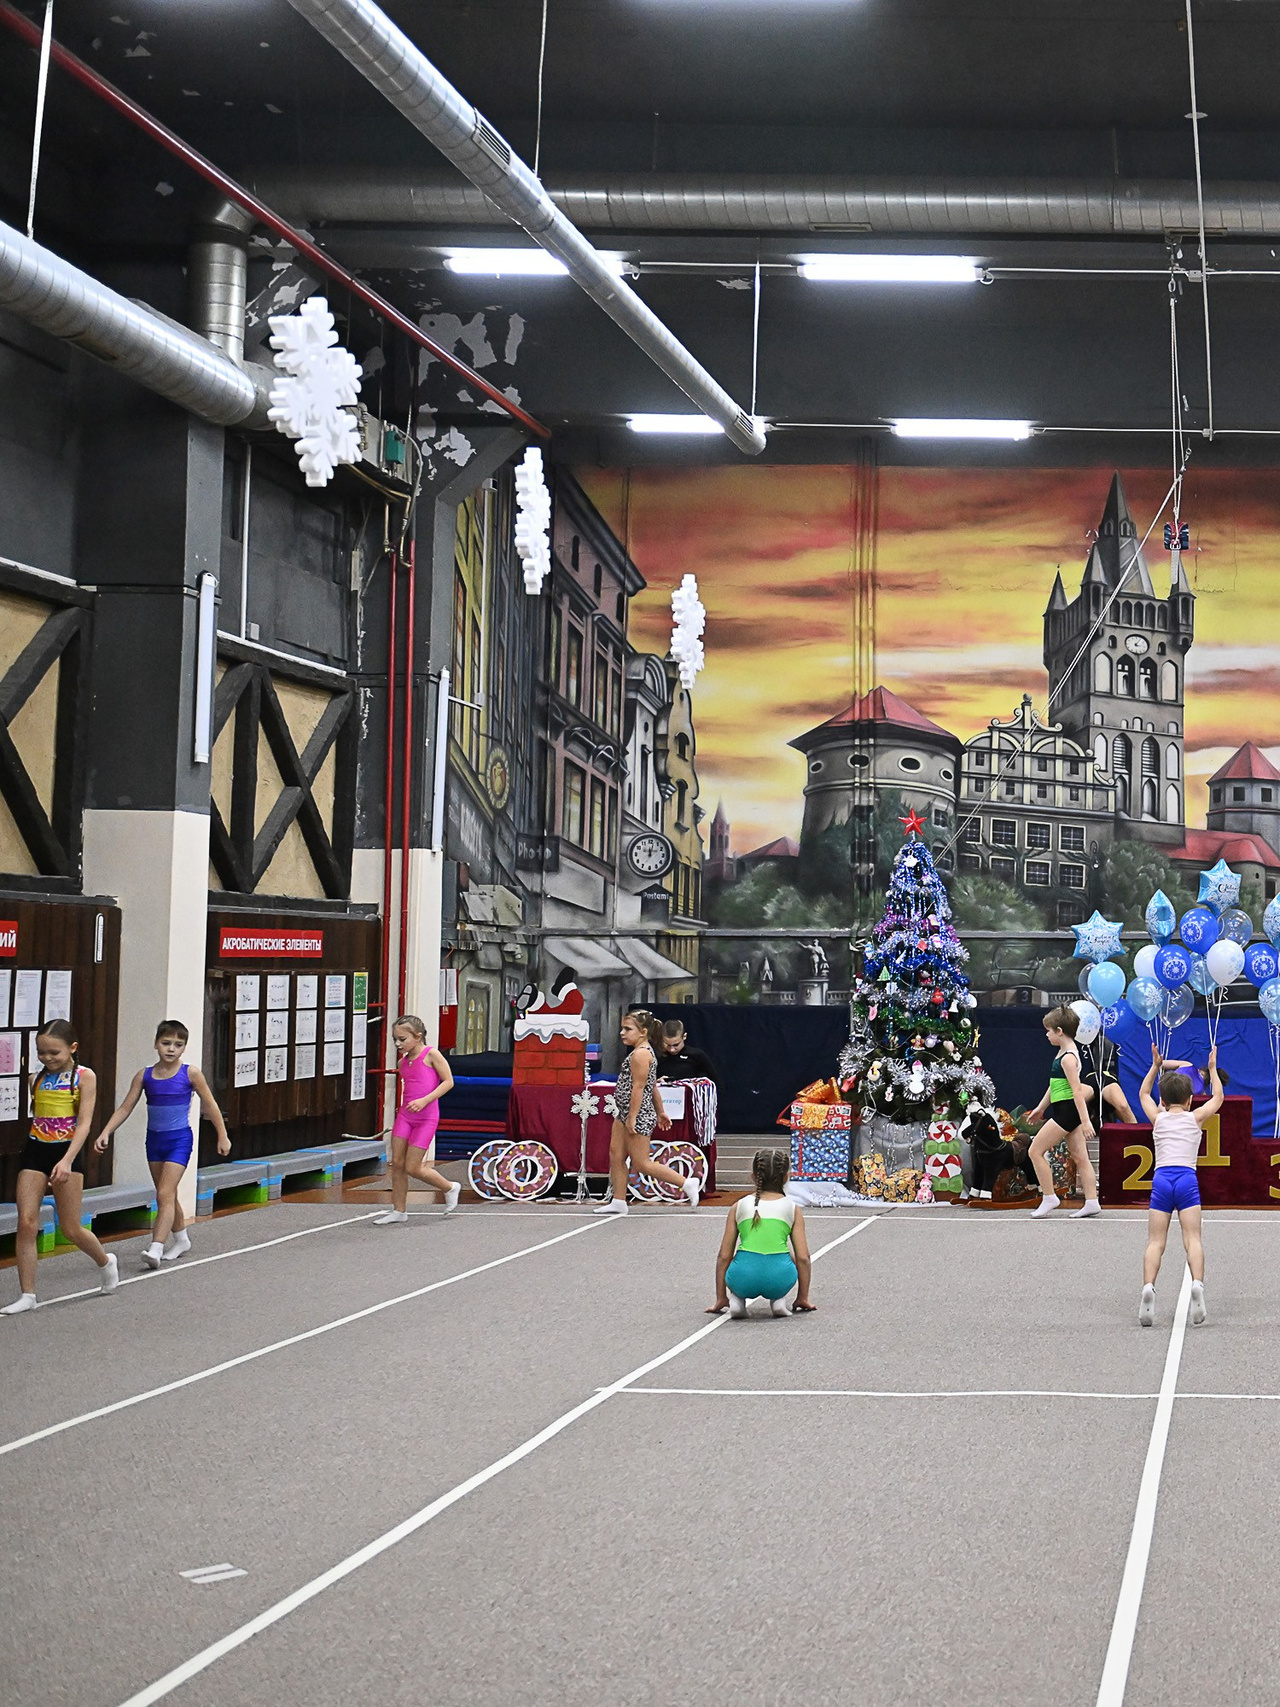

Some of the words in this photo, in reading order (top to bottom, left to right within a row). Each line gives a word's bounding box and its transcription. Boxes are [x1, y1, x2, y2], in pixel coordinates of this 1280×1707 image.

[222, 937, 286, 951] АКРОБАТИЧЕСКИЕ
[286, 938, 322, 951] ЭЛЕМЕНТЫ
[1197, 1114, 1231, 1166] 1
[1122, 1145, 1154, 1190] 2
